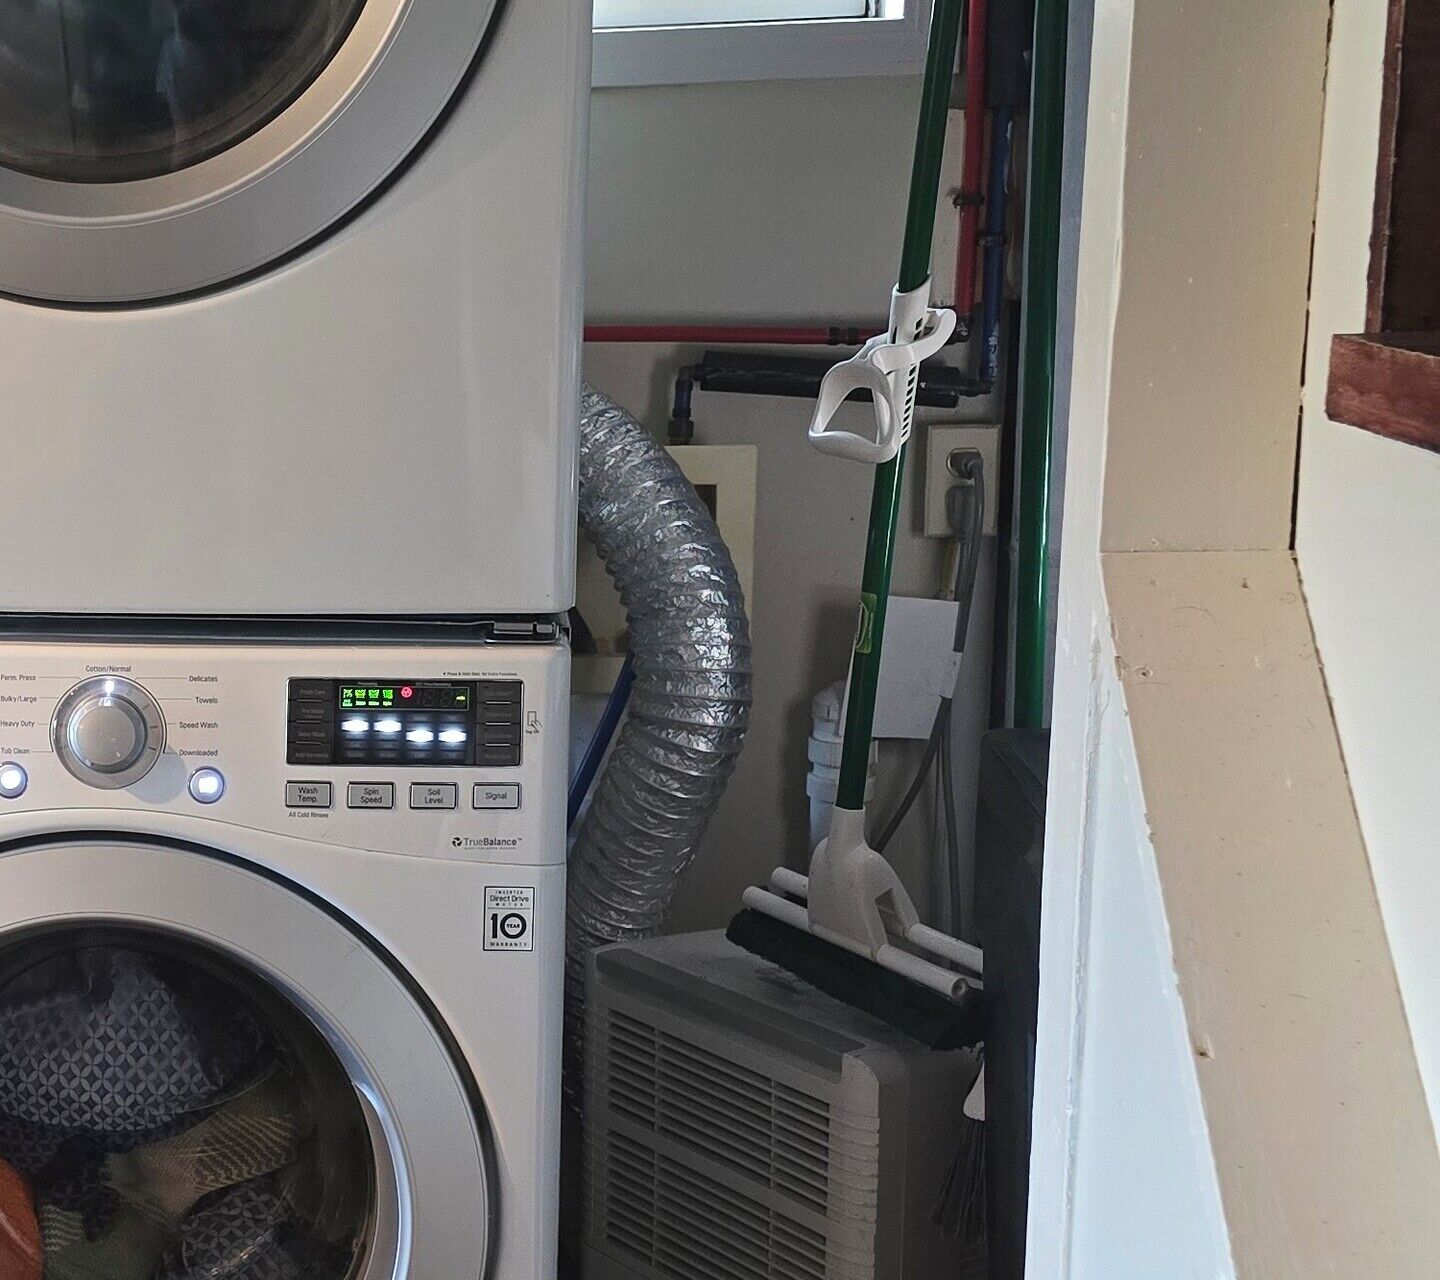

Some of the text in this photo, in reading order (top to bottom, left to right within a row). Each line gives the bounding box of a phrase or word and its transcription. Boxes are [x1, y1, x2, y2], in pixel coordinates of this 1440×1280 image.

[196, 696, 218, 704] Towels
[0, 720, 35, 728] Heavy Duty
[364, 788, 380, 796] Spin
[428, 788, 440, 796] Soil
[486, 792, 508, 800] Signal
[360, 796, 382, 804] Speed
[490, 912, 526, 939] 10
